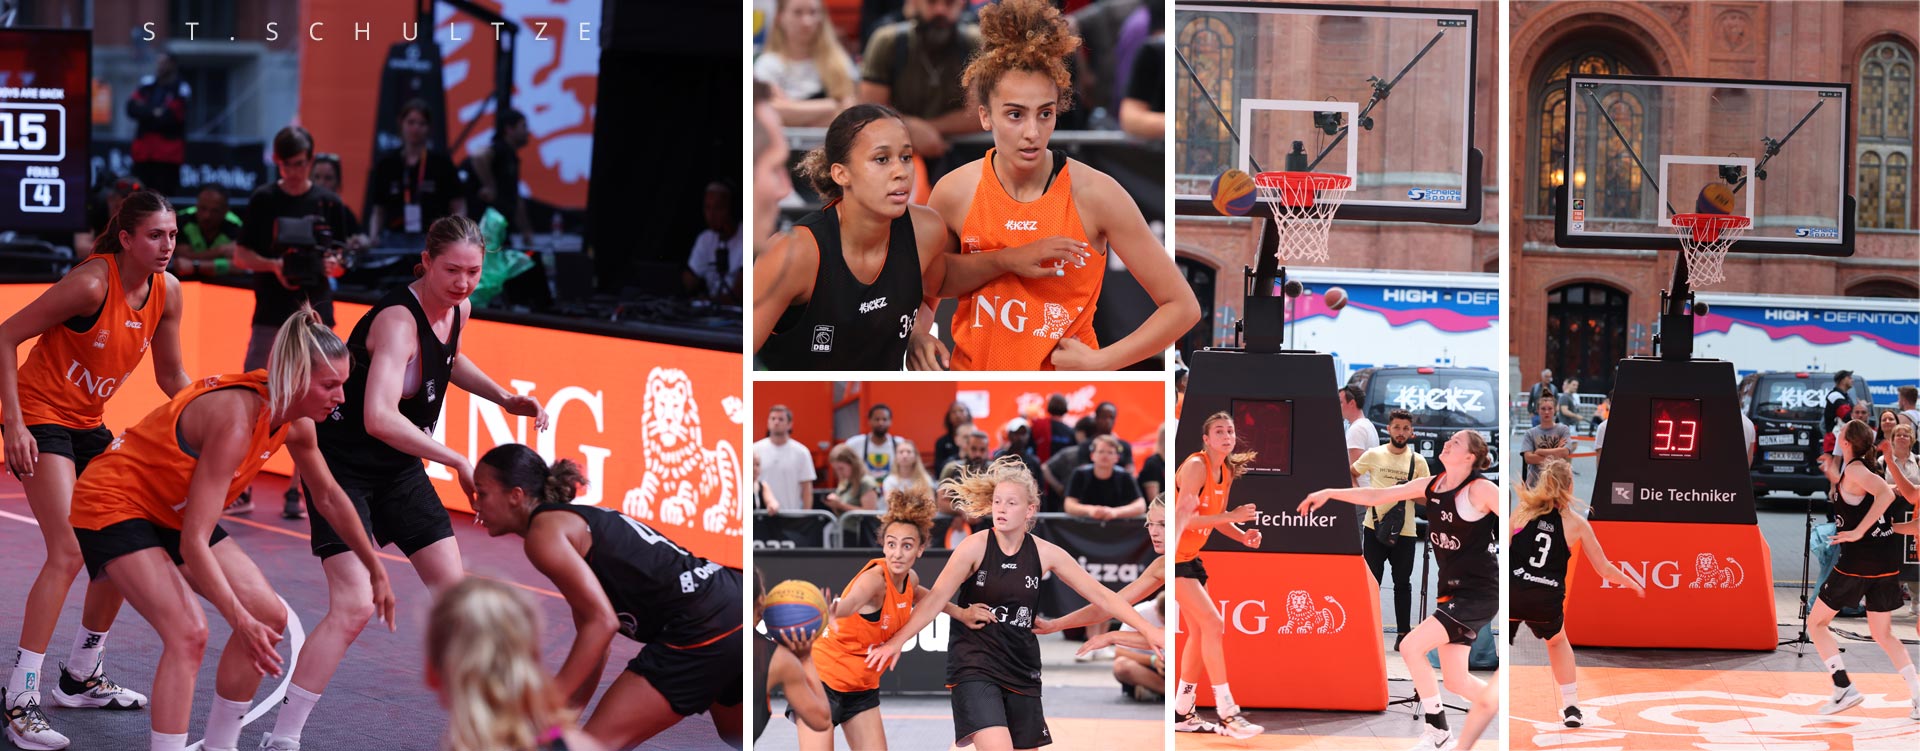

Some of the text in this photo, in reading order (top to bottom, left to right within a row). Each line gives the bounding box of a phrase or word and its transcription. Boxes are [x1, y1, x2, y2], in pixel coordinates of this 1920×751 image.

[0, 112, 47, 150] 15
[33, 183, 52, 206] 4
[1383, 288, 1438, 304] HIGH
[1764, 309, 1918, 325] HIGH DEFINITION
[65, 358, 117, 398] ING
[1654, 420, 1697, 451] 3.3
[1640, 488, 1736, 502] Die Techniker
[1254, 510, 1336, 527] Techniker
[1528, 532, 1552, 568] 3
